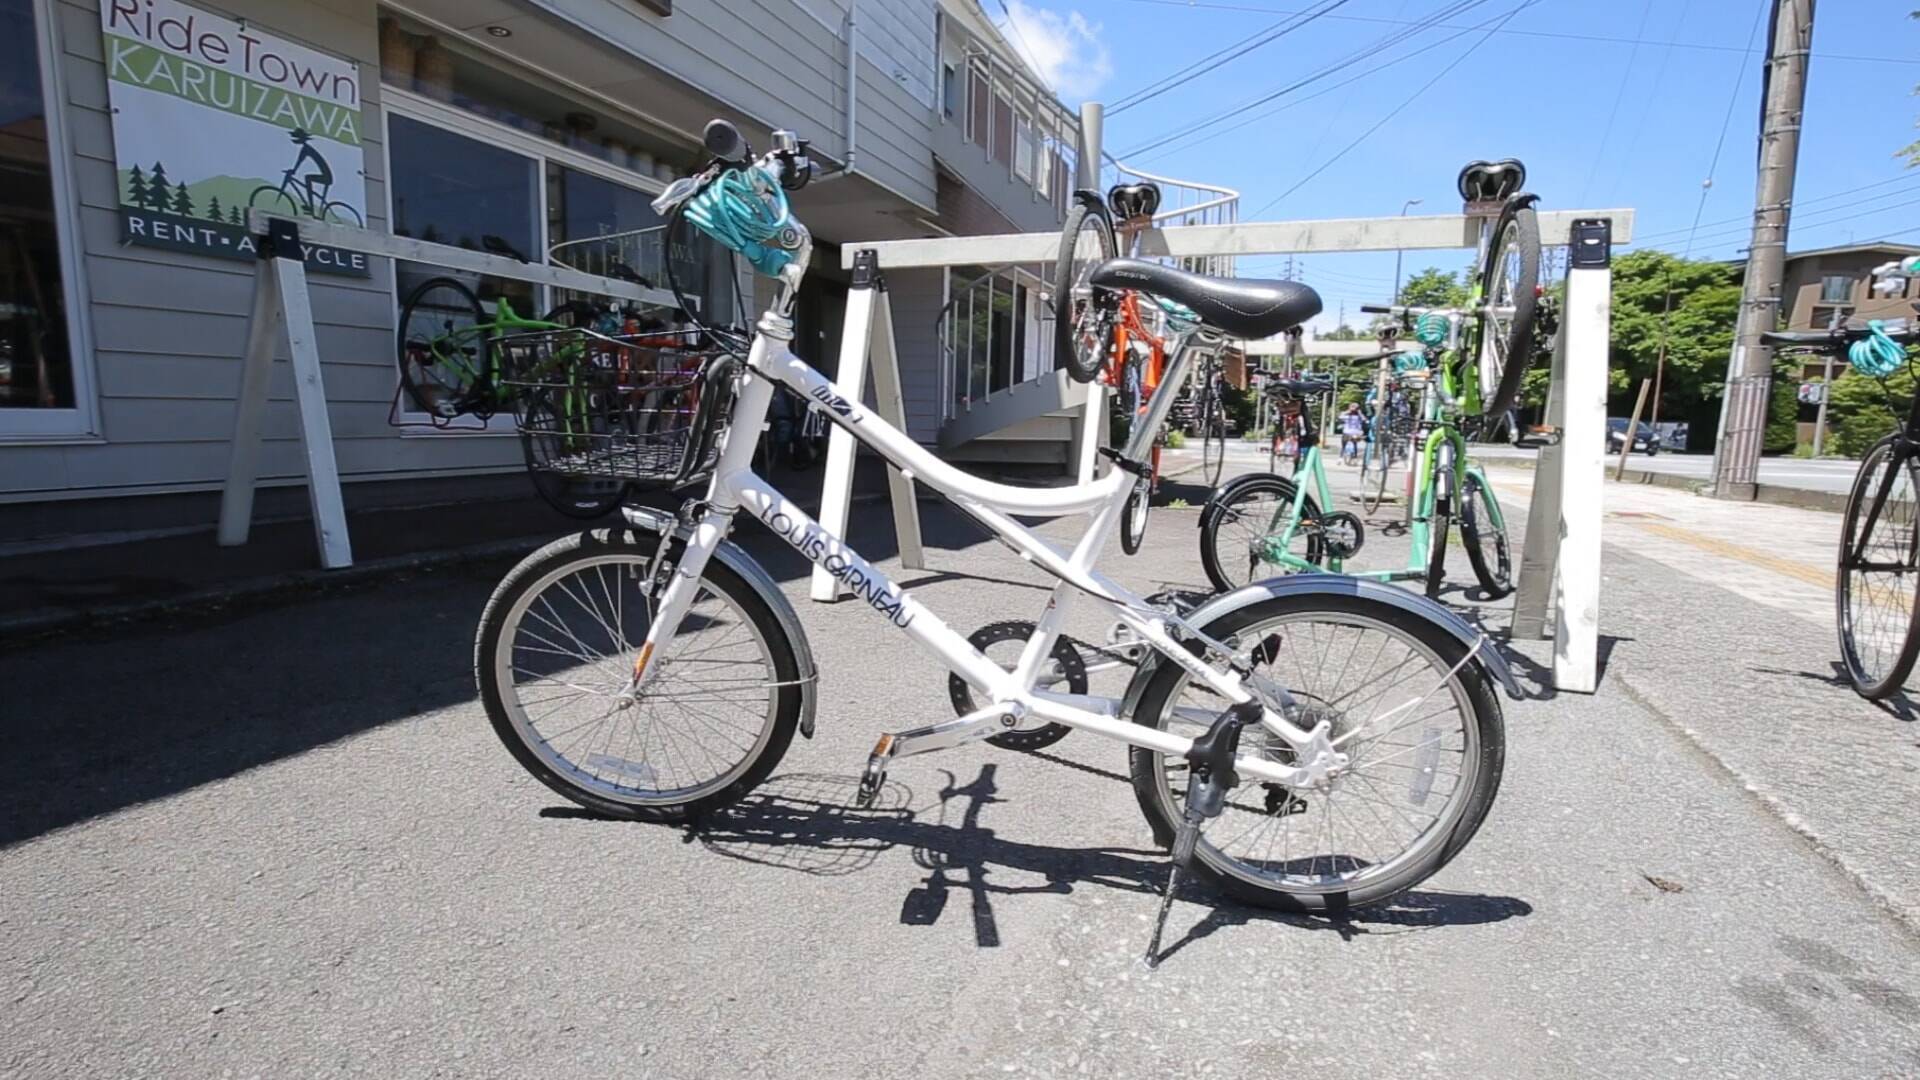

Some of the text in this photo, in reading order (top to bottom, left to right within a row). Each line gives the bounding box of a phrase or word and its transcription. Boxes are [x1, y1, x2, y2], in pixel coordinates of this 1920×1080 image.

[110, 38, 360, 145] KARUIZAWA
[299, 244, 366, 270] YCLE
[760, 503, 915, 629] LOUIS GARNEAU
